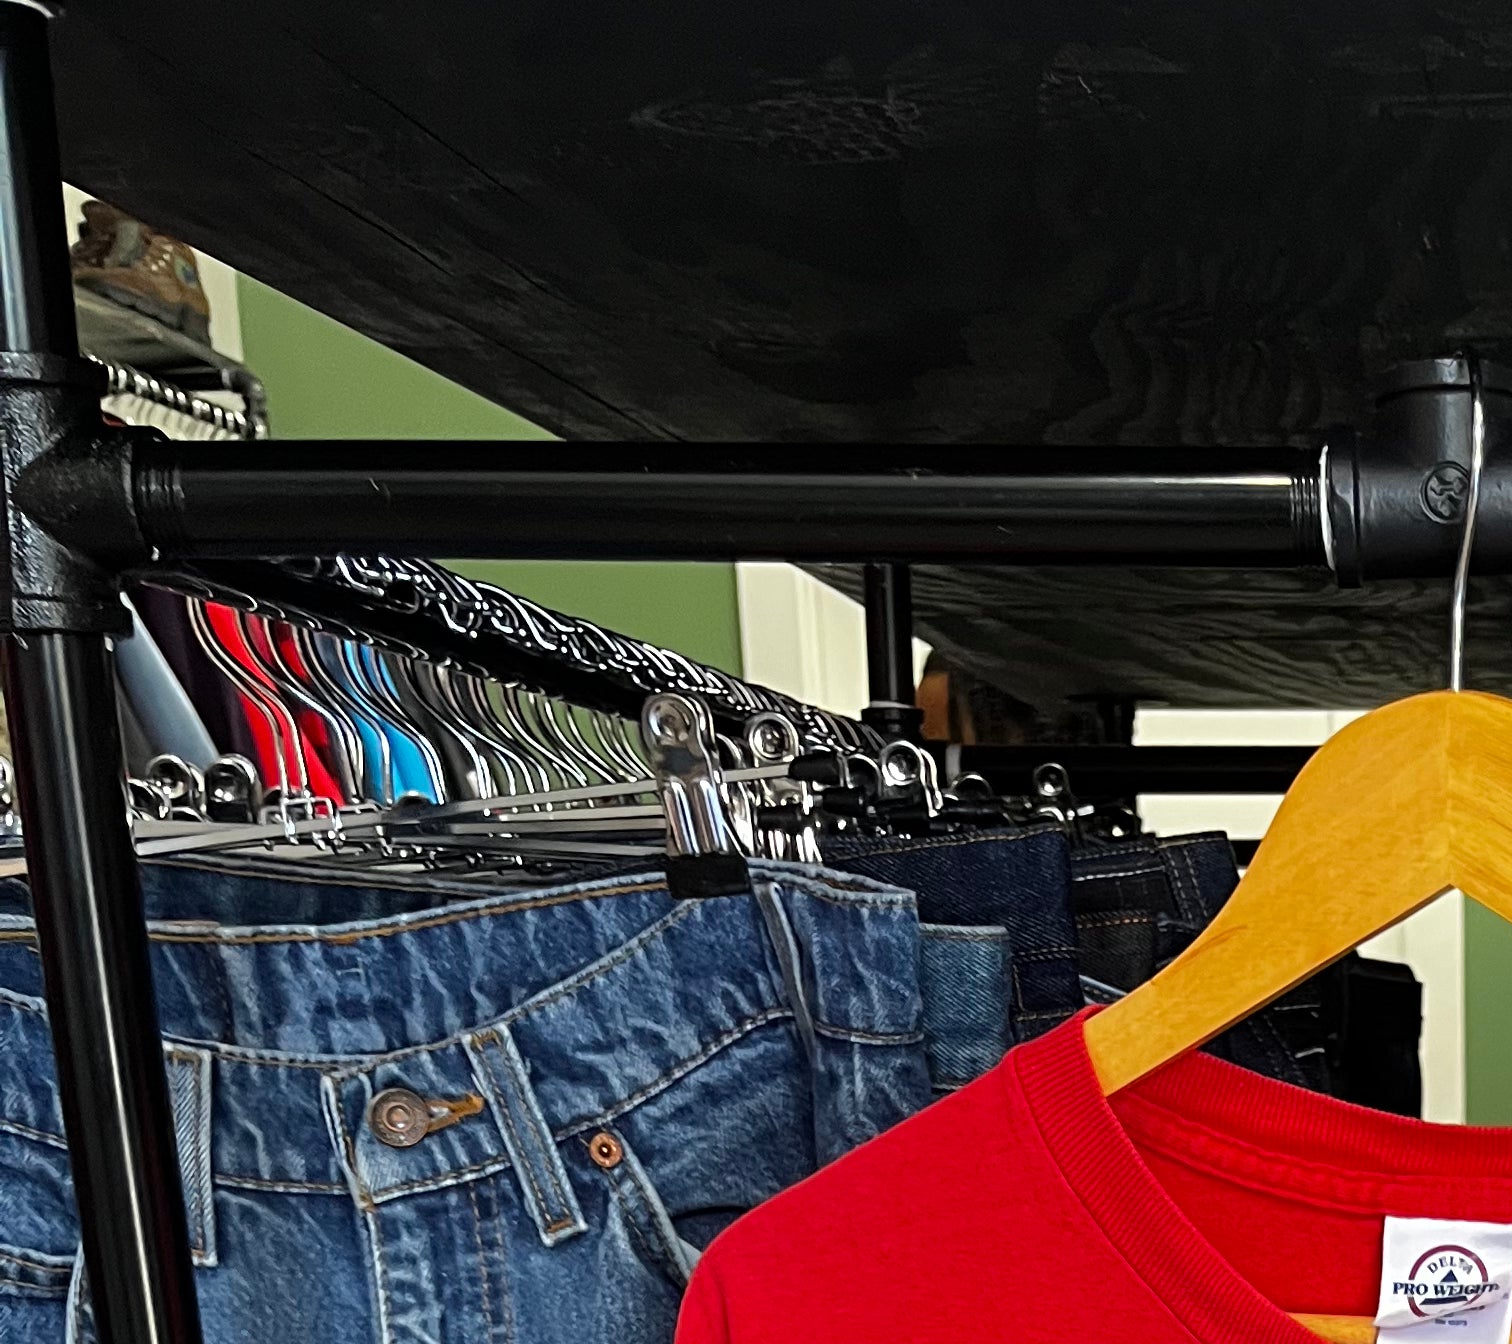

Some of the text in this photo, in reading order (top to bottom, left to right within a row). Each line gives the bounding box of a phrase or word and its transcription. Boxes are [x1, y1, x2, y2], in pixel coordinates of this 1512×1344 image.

[1427, 1256, 1473, 1275] DELTA
[1393, 1282, 1499, 1296] PRO WEIGHT
